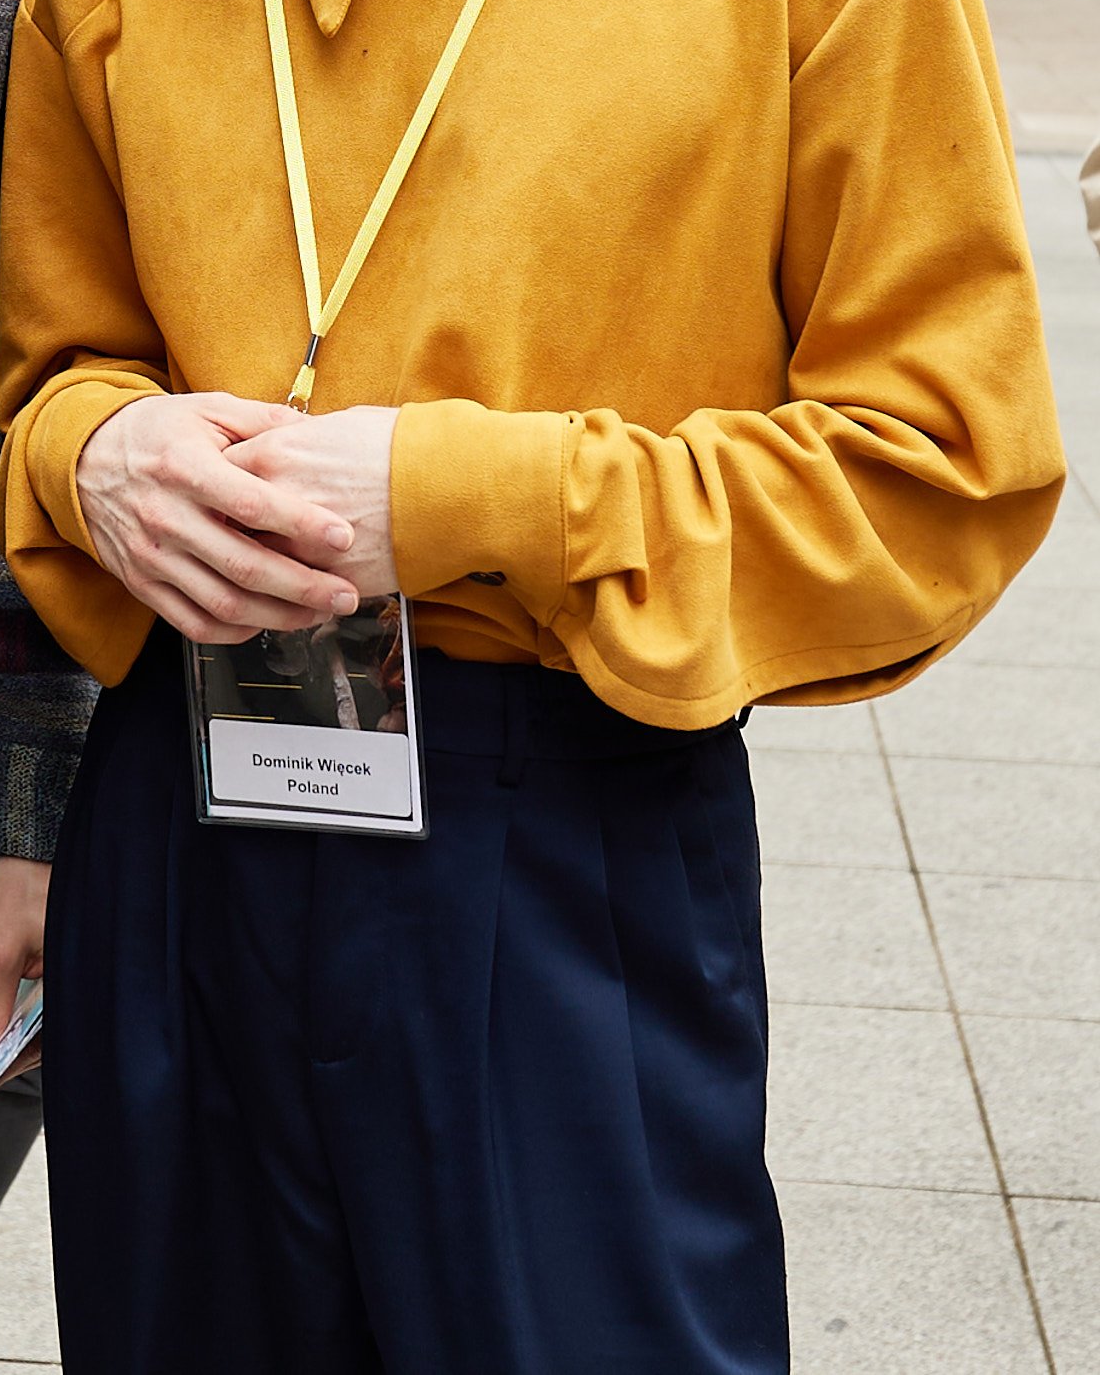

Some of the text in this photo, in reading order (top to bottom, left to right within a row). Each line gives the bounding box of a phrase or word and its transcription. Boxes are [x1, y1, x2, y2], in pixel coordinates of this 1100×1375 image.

[252, 753, 371, 776] Dominik Więcek
[287, 779, 339, 796] Poland
